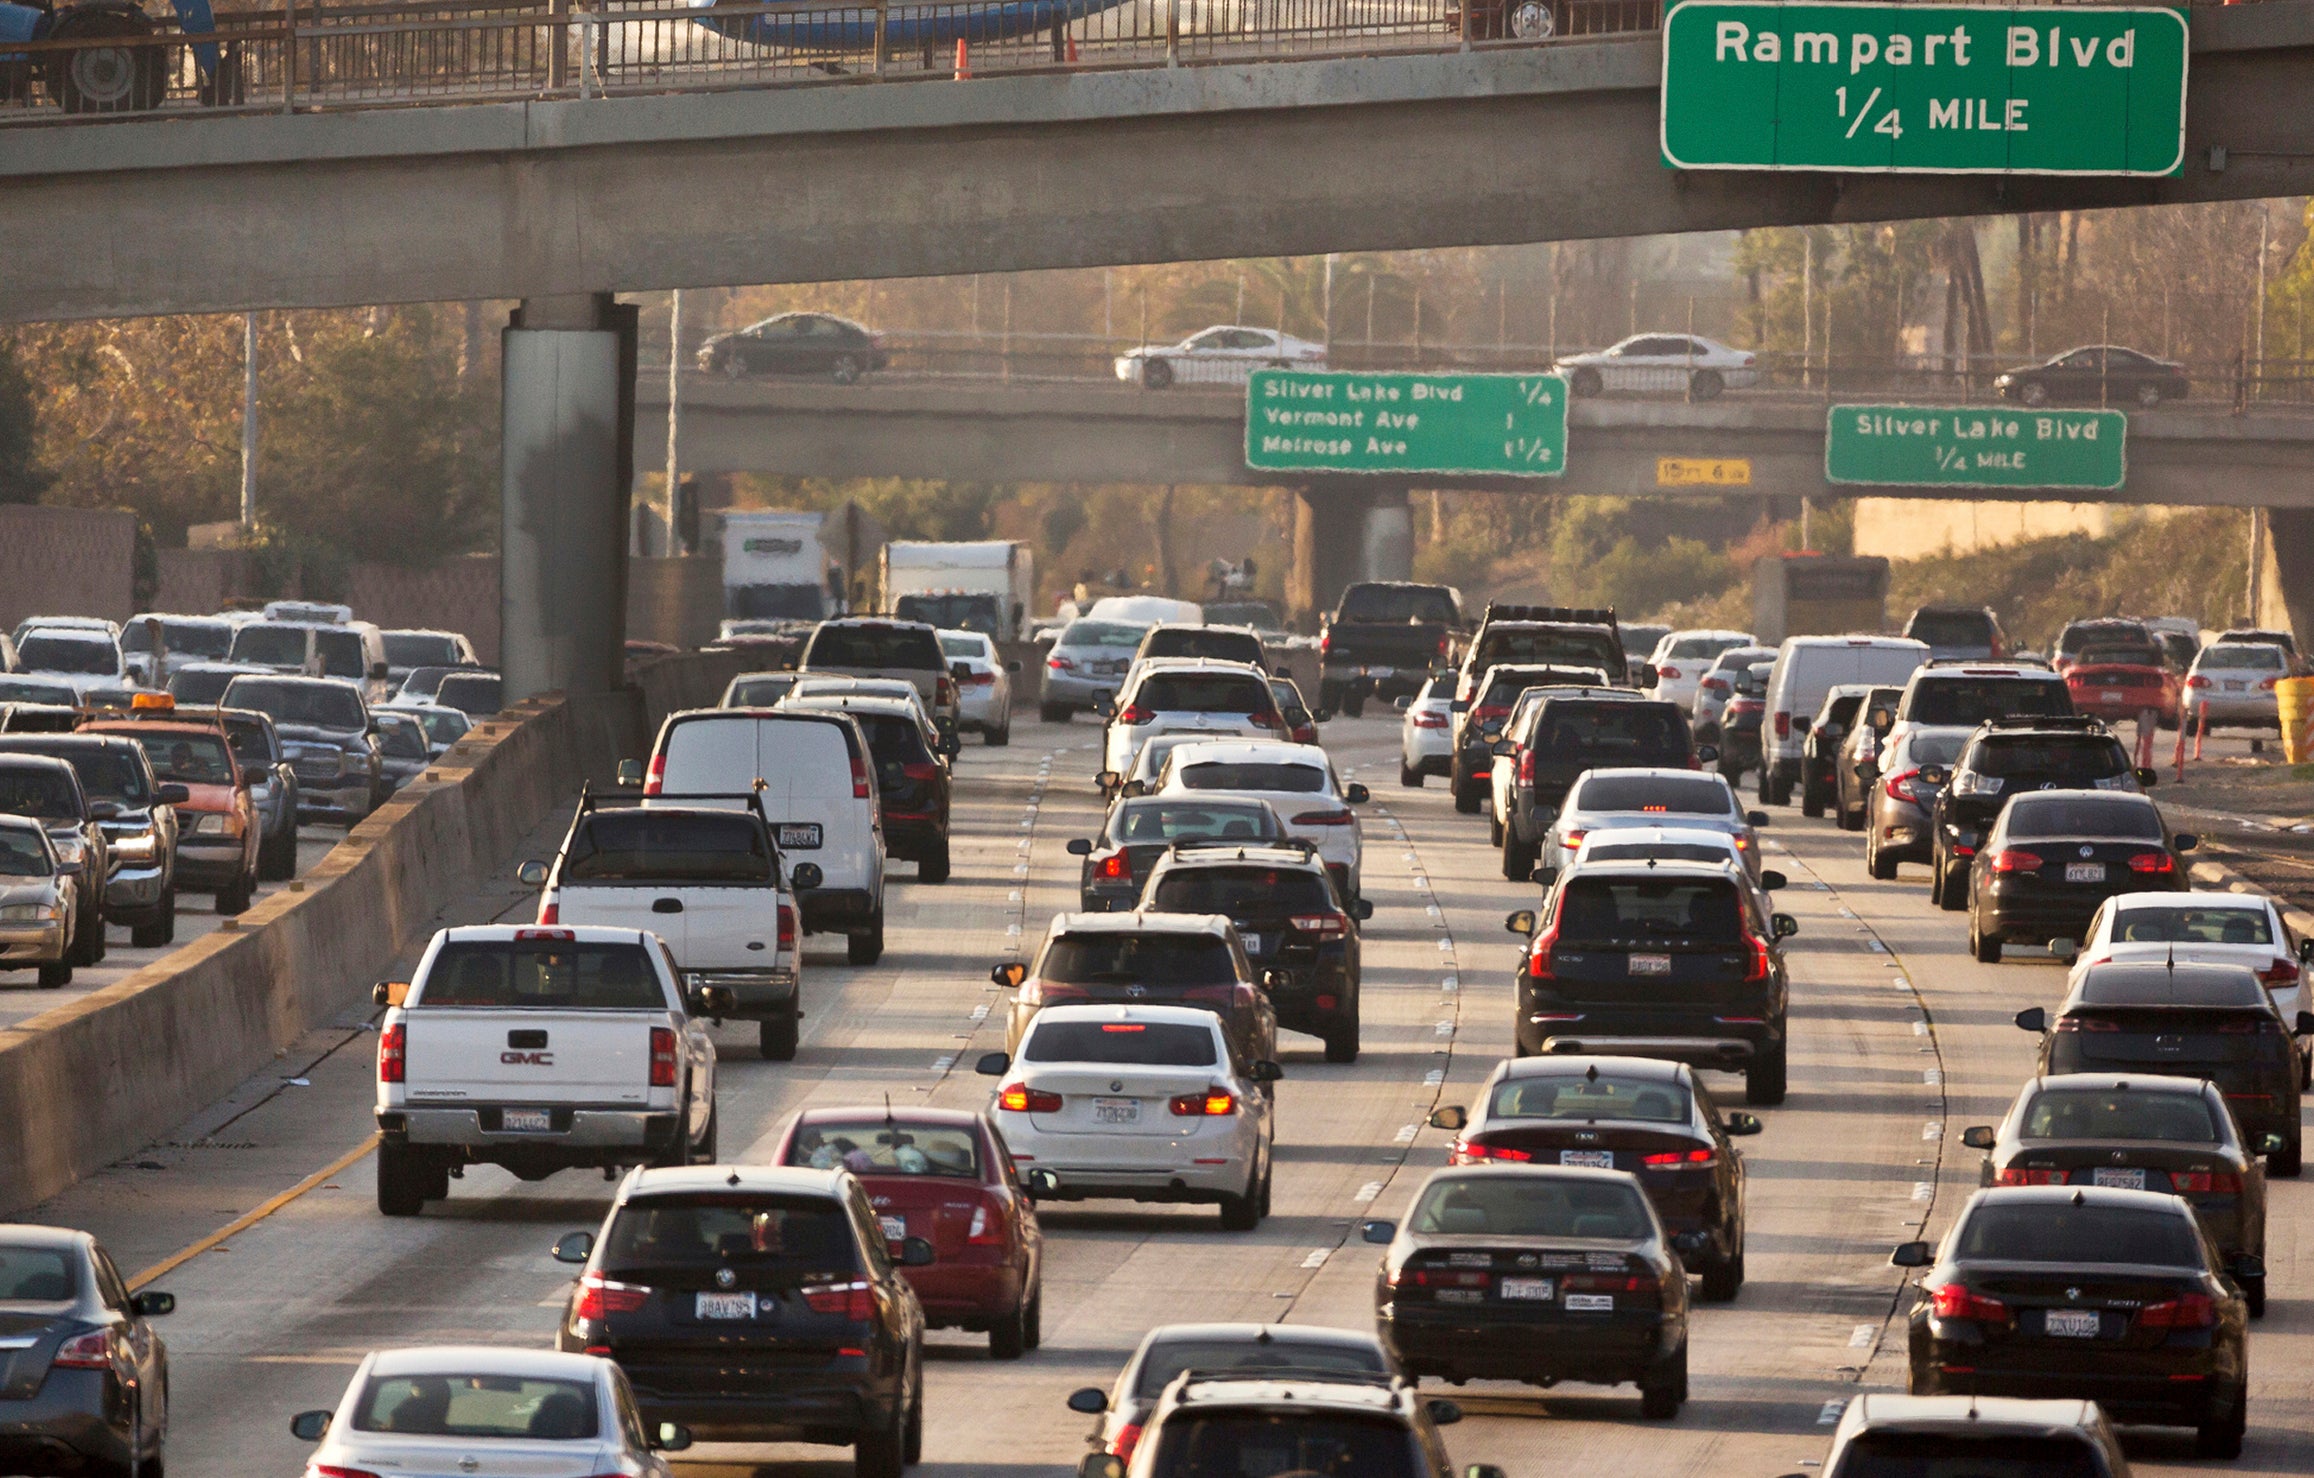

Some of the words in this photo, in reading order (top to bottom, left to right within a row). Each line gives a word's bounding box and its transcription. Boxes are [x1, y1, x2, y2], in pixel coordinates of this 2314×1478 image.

[1714, 21, 1972, 75] Rampart
[2006, 26, 2136, 68] Blvd
[1834, 86, 1904, 139] 1/4
[1928, 98, 2030, 131] MILE
[1263, 379, 1335, 398] Silver
[1347, 382, 1400, 401] Lake
[1410, 382, 1463, 402] Blvd
[1518, 380, 1552, 405] 1/4
[1263, 407, 1364, 427] Vermont
[1376, 409, 1420, 430] Ave
[1856, 414, 1942, 436] Silver
[1953, 416, 2020, 439] Lake
[2035, 418, 2099, 441] Blvd
[1262, 436, 1352, 455] Melrose
[1365, 436, 1408, 455] Ave
[1935, 446, 1967, 471] 1/4
[1976, 452, 2026, 469] MILE
[500, 1052, 553, 1066] GMC
